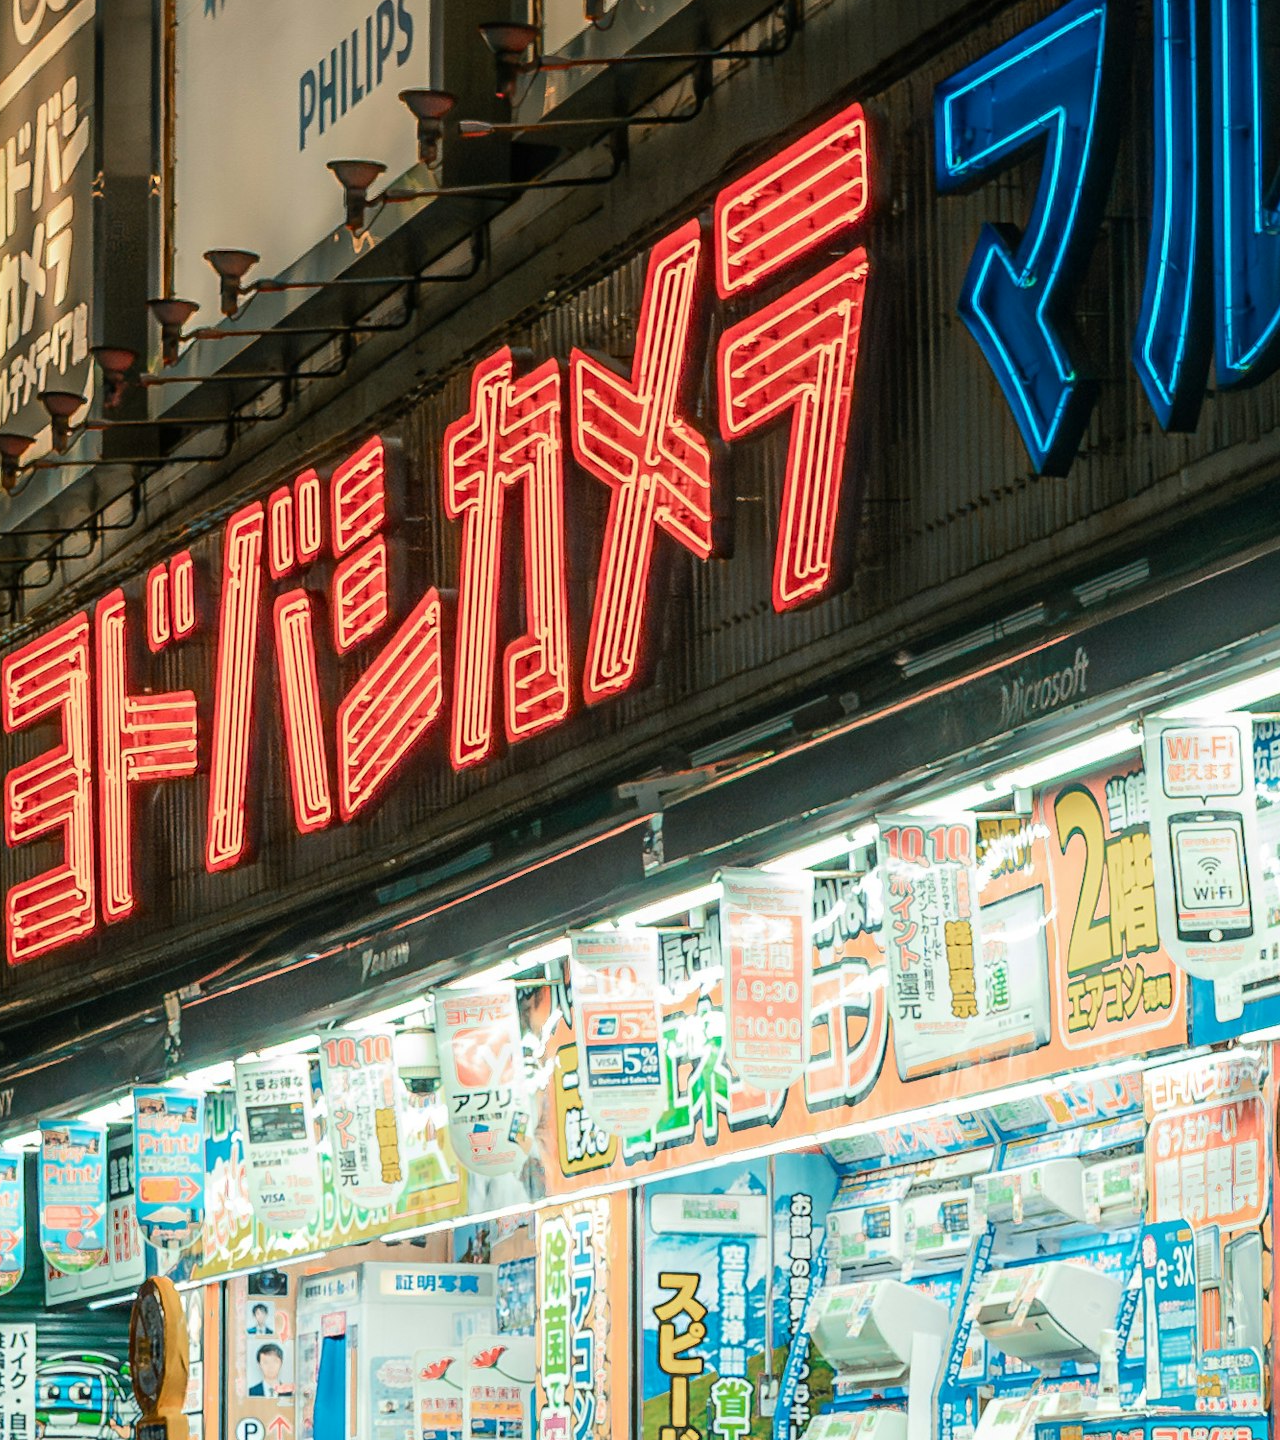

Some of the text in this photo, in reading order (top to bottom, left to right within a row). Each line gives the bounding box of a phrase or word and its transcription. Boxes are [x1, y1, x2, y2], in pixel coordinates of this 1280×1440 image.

[1, 100, 869, 967] ヨドバシカメラ
[1167, 734, 1234, 762] Wi-Fi
[1167, 762, 1233, 784] 使えます
[1054, 783, 1161, 981] 2階
[1193, 885, 1233, 902] Wi-Fi
[741, 943, 794, 971] 時間
[888, 873, 923, 1021] ポイント還元
[749, 978, 800, 1003] 9:30
[1067, 963, 1172, 1034] エアコン売場
[445, 1010, 512, 1026] ヨドバシ
[744, 1016, 801, 1039] 10:00
[595, 1055, 620, 1068] VISA
[137, 1111, 185, 1133] Enjoy
[42, 1143, 88, 1163] Enjoy
[137, 1133, 201, 1156] Print!
[42, 1163, 101, 1185] Print!
[260, 1192, 286, 1205] VISA
[1155, 1244, 1194, 1289] e-3X
[393, 1273, 481, 1295] 証明写真
